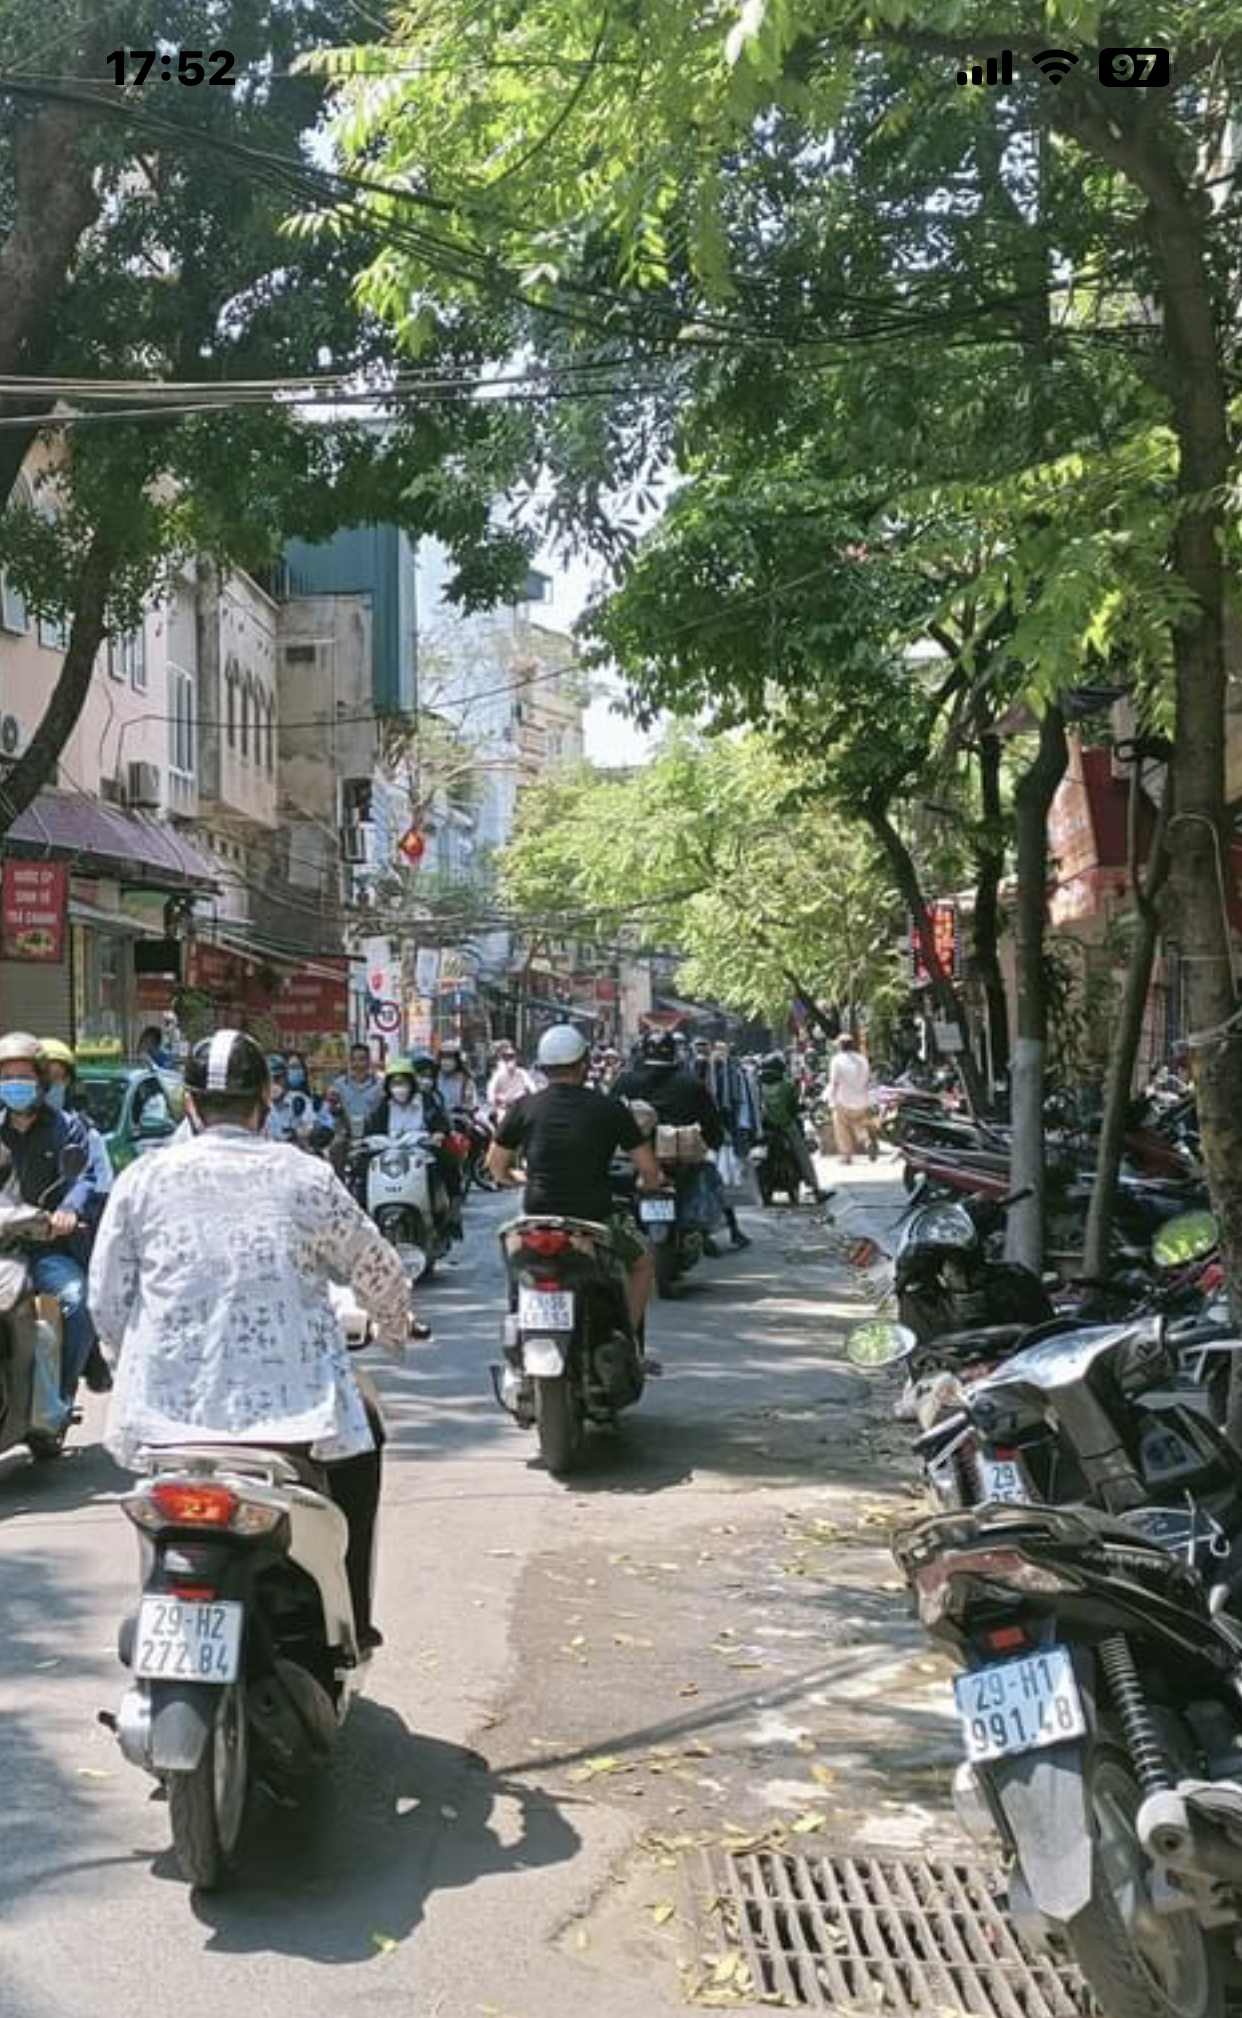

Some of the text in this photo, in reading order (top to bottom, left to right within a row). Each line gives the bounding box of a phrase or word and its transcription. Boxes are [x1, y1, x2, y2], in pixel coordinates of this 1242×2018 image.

[991, 1464, 1016, 1489] 29
[152, 1604, 227, 1640] 29-H2
[972, 1658, 1053, 1712] 29-H1
[971, 1696, 1074, 1752] 991.48
